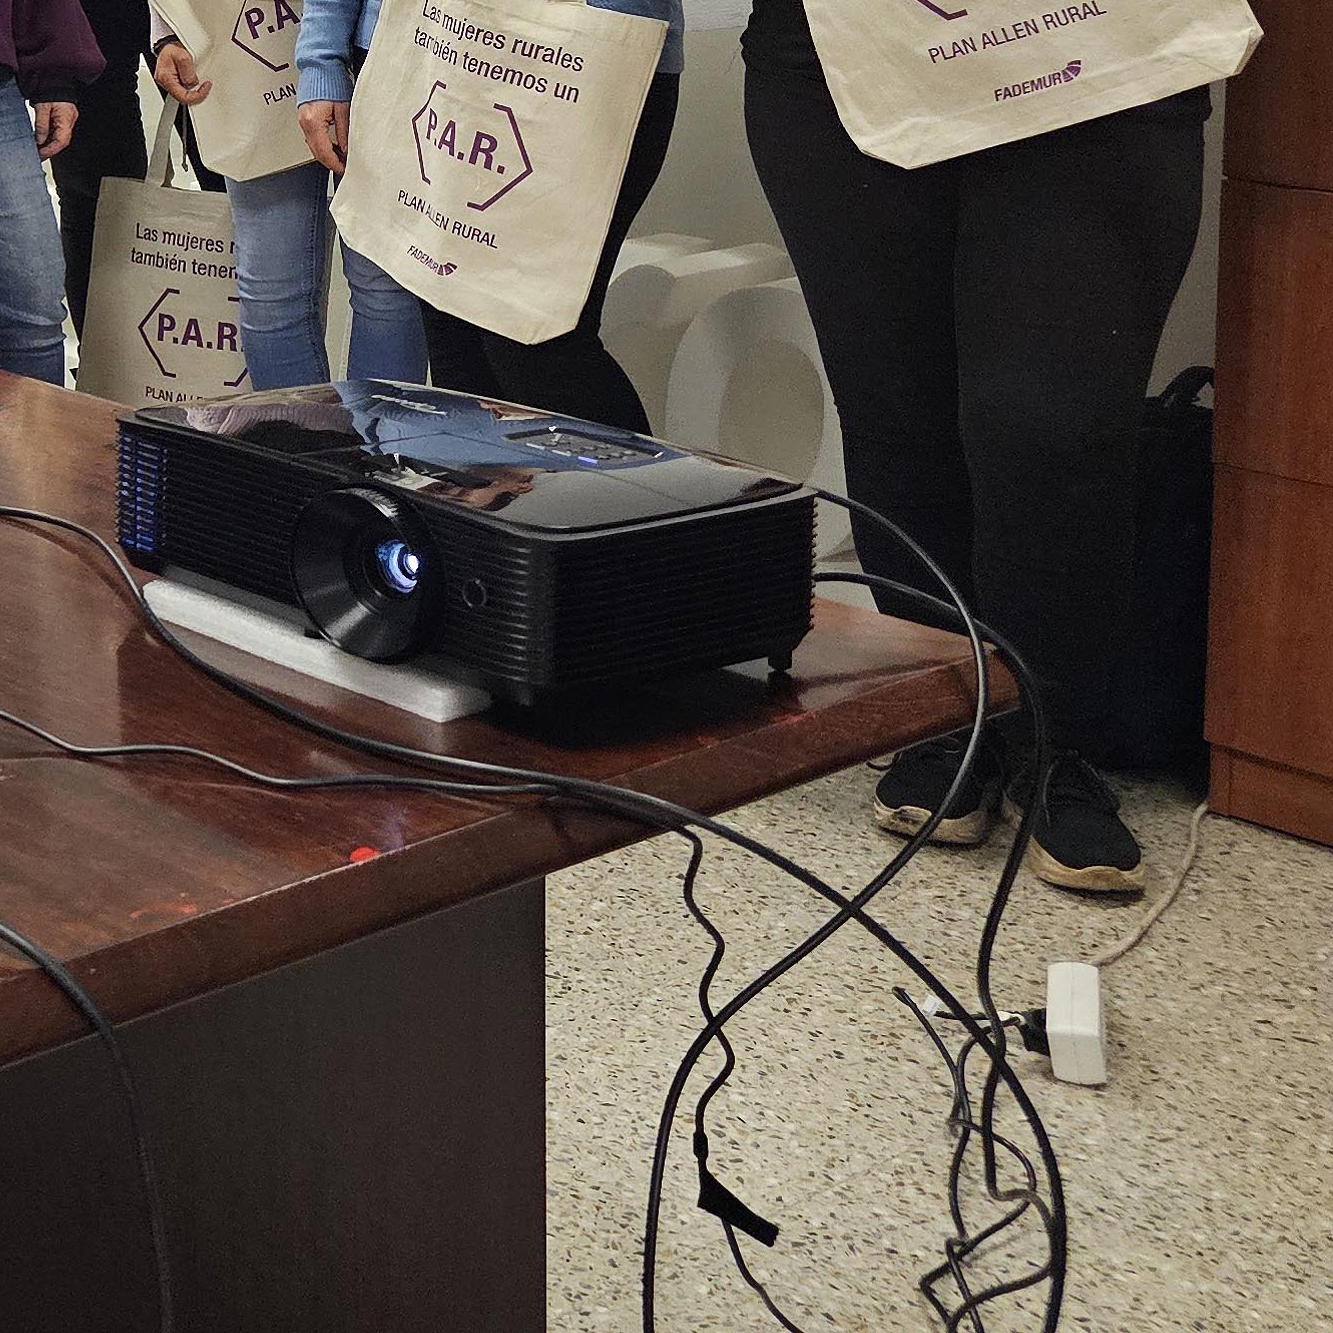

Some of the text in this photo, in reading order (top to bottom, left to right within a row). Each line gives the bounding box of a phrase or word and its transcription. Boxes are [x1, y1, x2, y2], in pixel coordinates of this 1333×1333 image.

[441, 11, 506, 51] mujeres
[511, 40, 585, 73] rurales
[927, 0, 1108, 65] PLAN ALLEN RURAL
[461, 52, 548, 93] tenemos
[553, 81, 580, 103] un
[994, 71, 1063, 102] FADEMUR
[263, 83, 297, 105] PLAN
[426, 107, 506, 175] P.A.R.
[397, 190, 427, 215] PLAN
[451, 221, 499, 250] RURAL
[136, 222, 158, 242] Las
[162, 229, 224, 253] mujeres
[131, 248, 186, 274] también
[406, 244, 439, 274] FADEMUR
[145, 386, 173, 403] PLAN
